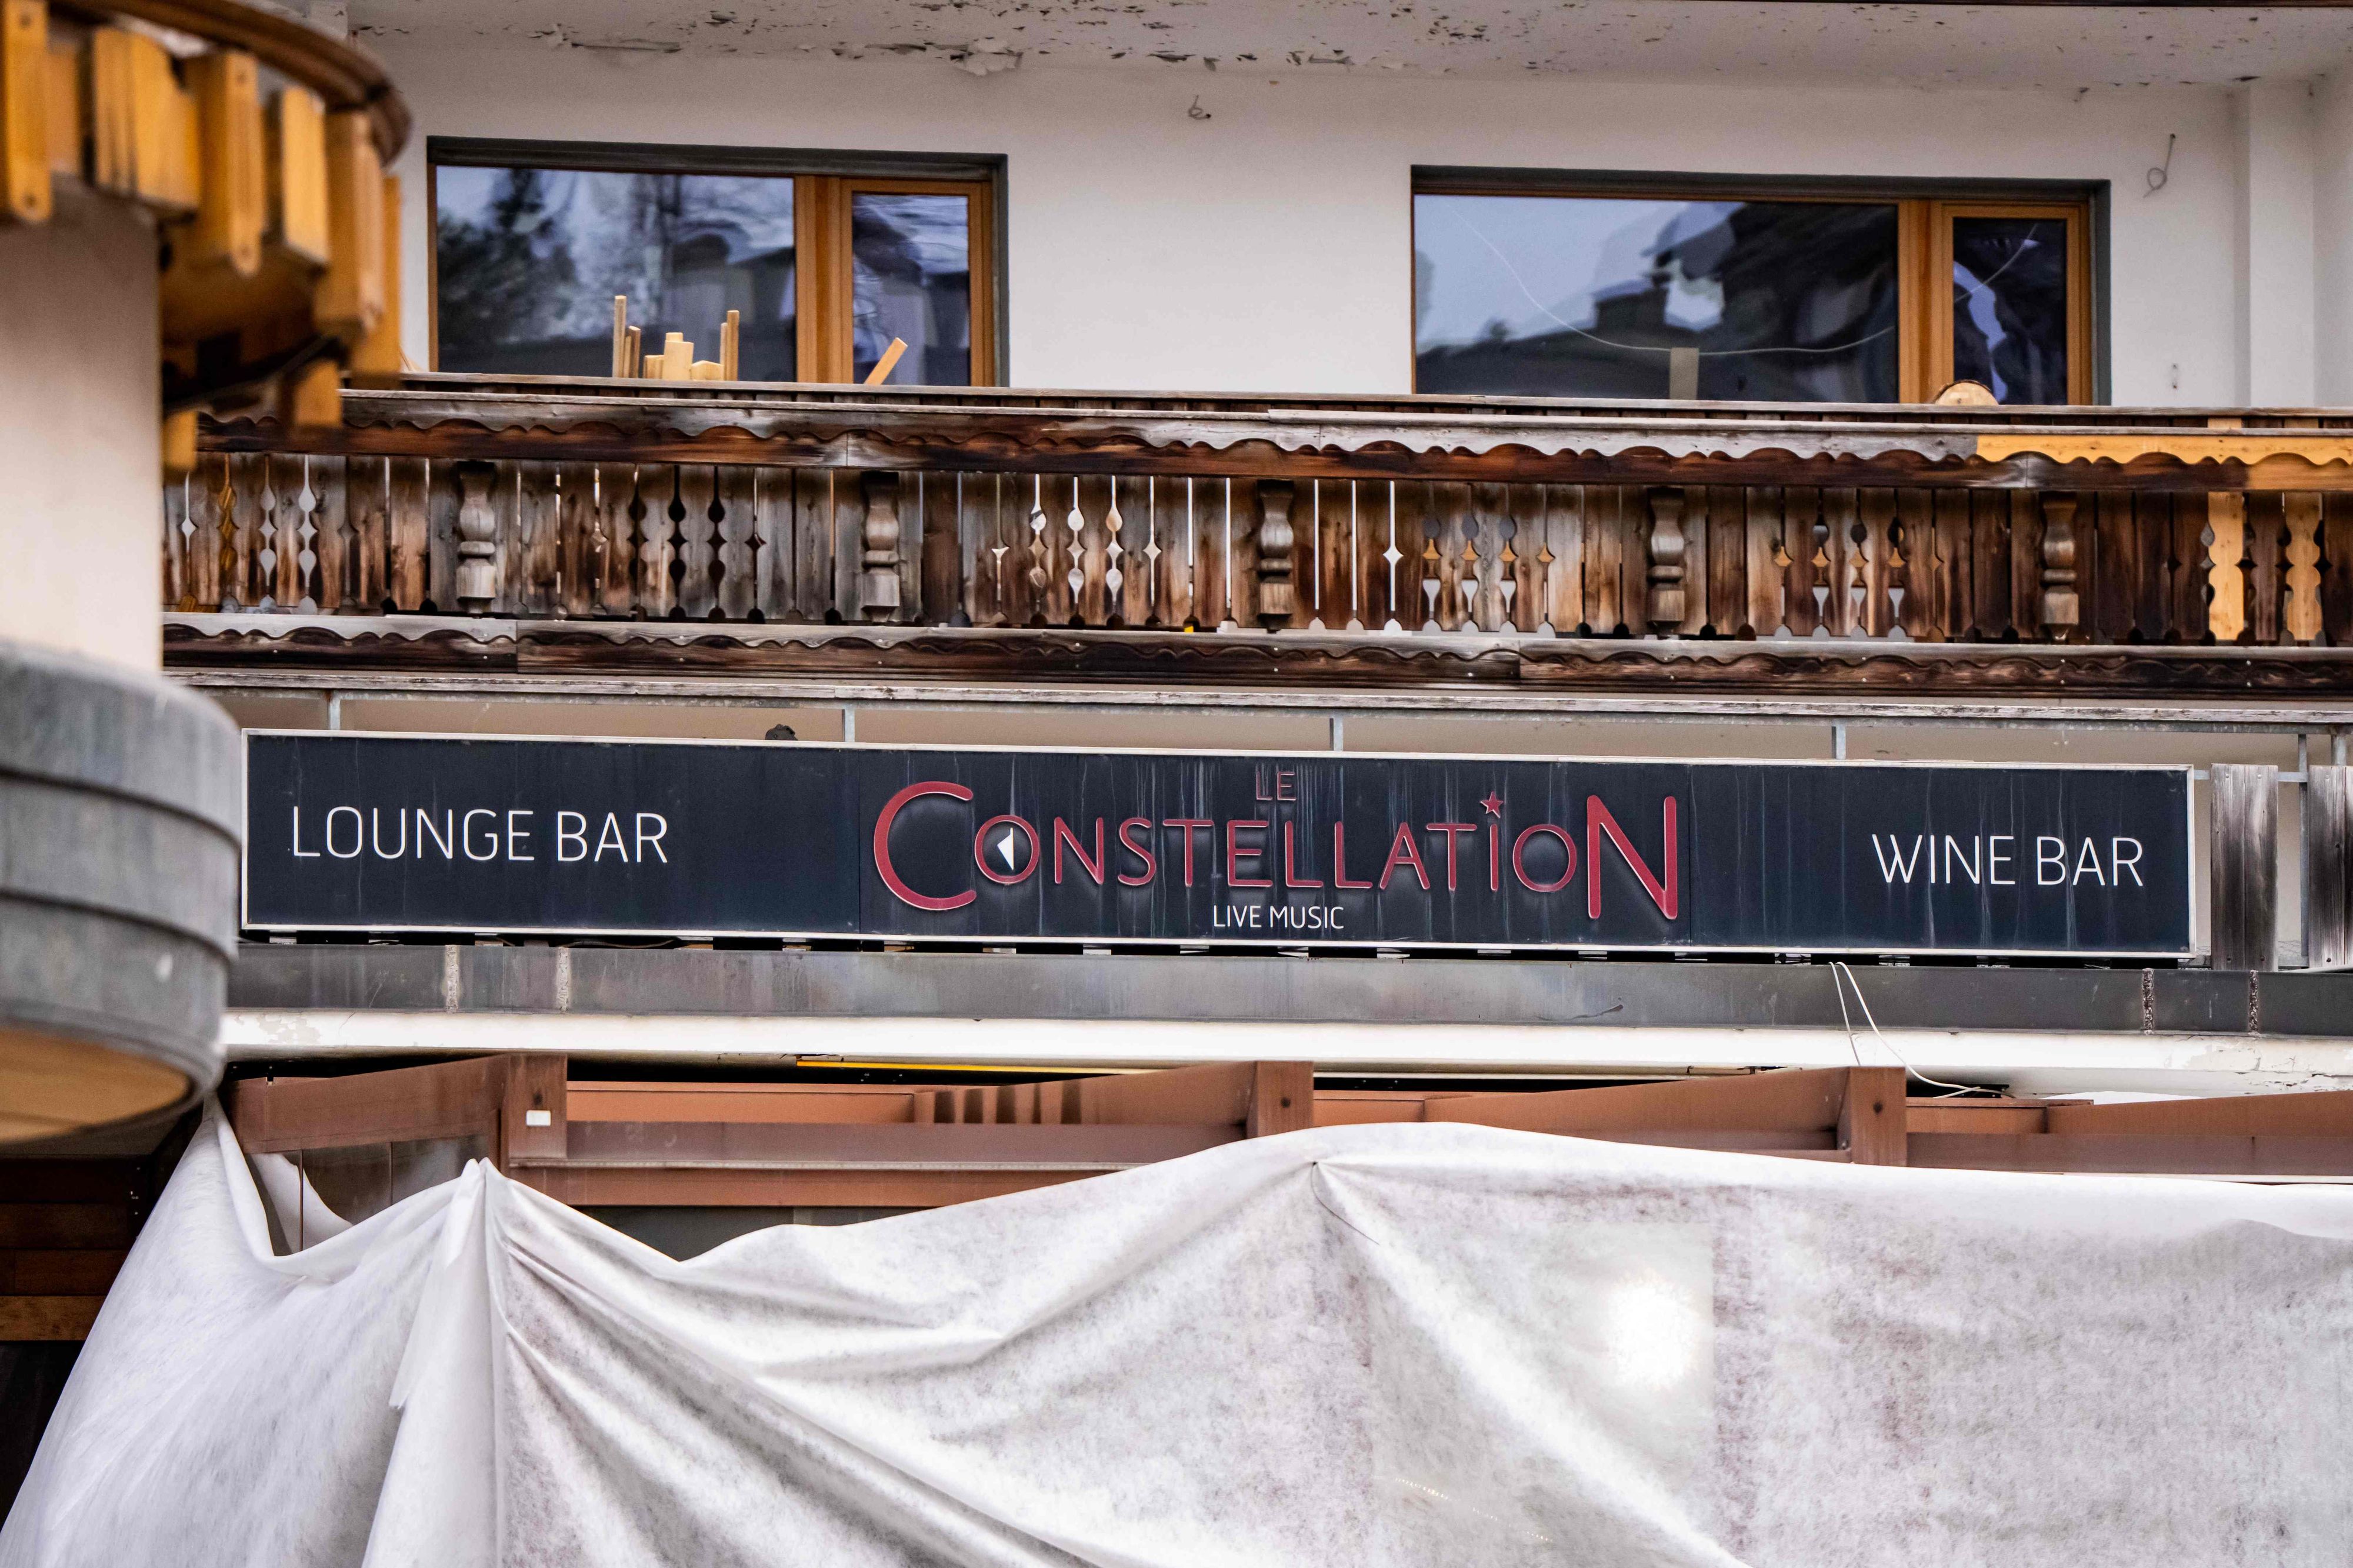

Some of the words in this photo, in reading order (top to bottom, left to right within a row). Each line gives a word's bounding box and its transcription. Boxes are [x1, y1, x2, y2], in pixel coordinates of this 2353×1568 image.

[1256, 770, 1297, 802] LE
[292, 805, 534, 862] LOUNGE
[556, 810, 668, 864] BAR
[873, 780, 1678, 920] CONSTELLATION
[1871, 833, 2016, 885] WINE
[2037, 835, 2143, 887] BAR
[1213, 905, 1262, 928] LIVE
[1269, 905, 1345, 929] MUSIC
